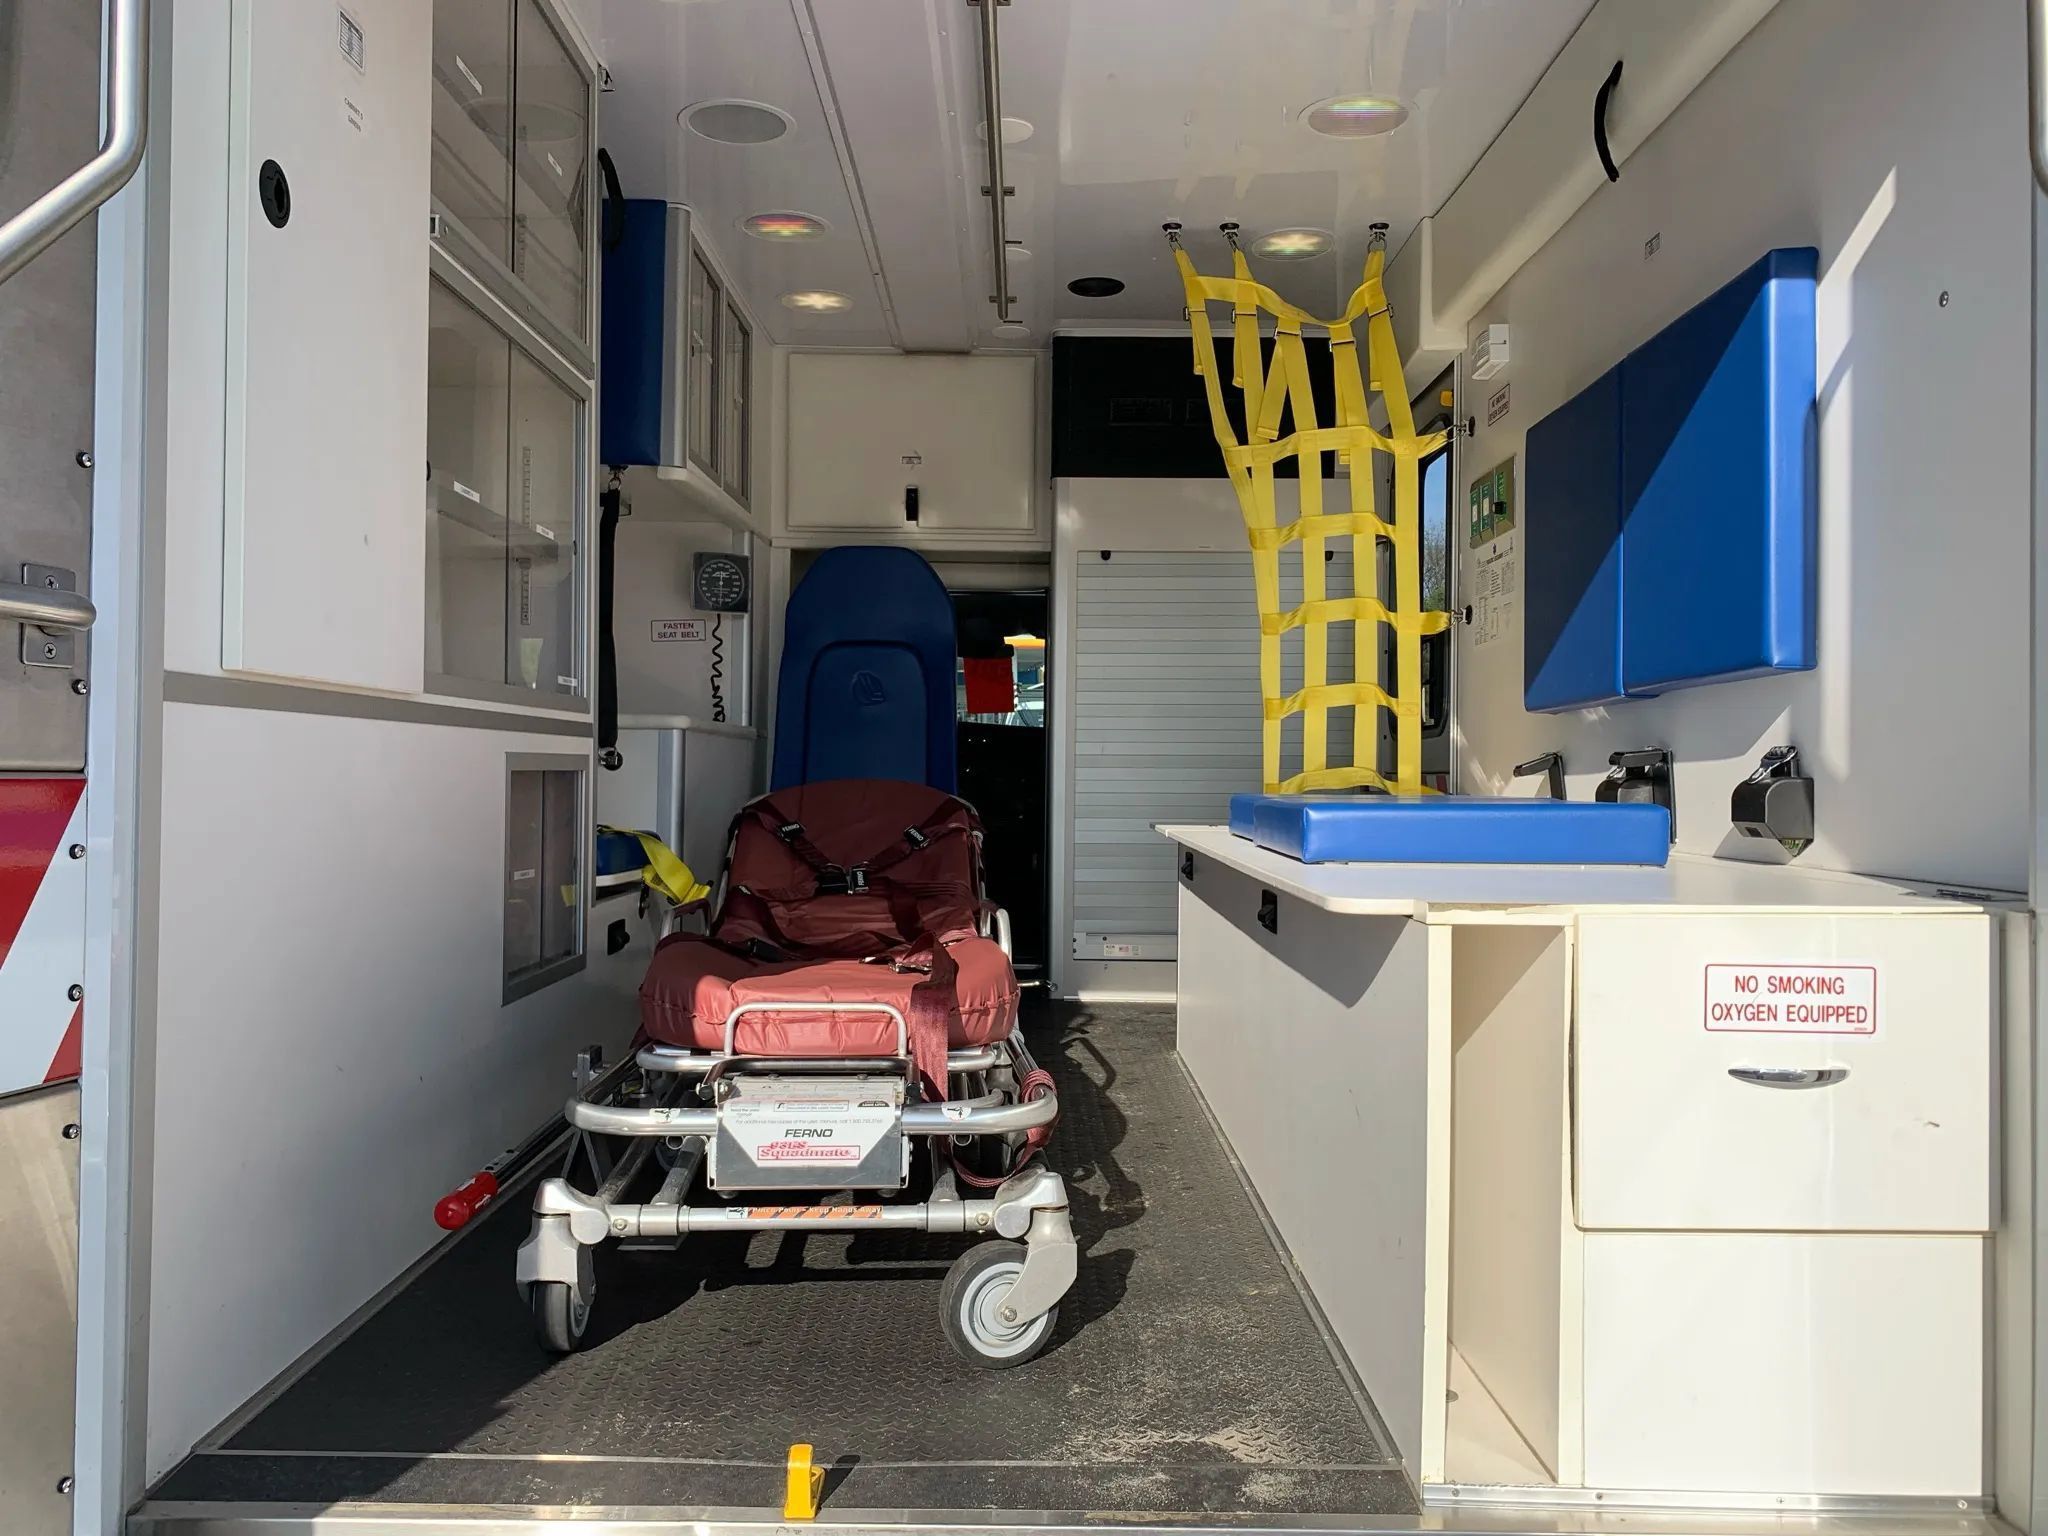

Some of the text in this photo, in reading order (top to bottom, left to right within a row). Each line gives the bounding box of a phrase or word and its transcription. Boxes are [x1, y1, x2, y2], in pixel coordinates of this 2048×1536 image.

[663, 622, 694, 630] FASTEN
[657, 631, 677, 639] SEAT
[781, 823, 800, 832] FERNO
[909, 827, 924, 842] FERNO
[856, 871, 865, 886] FERNO
[1734, 975, 1845, 995] NO SMOKING
[1711, 1003, 1868, 1024] OXYGEN EQUIPPED
[784, 1129, 834, 1138] FERNO
[760, 1149, 850, 1159] Squadmate
